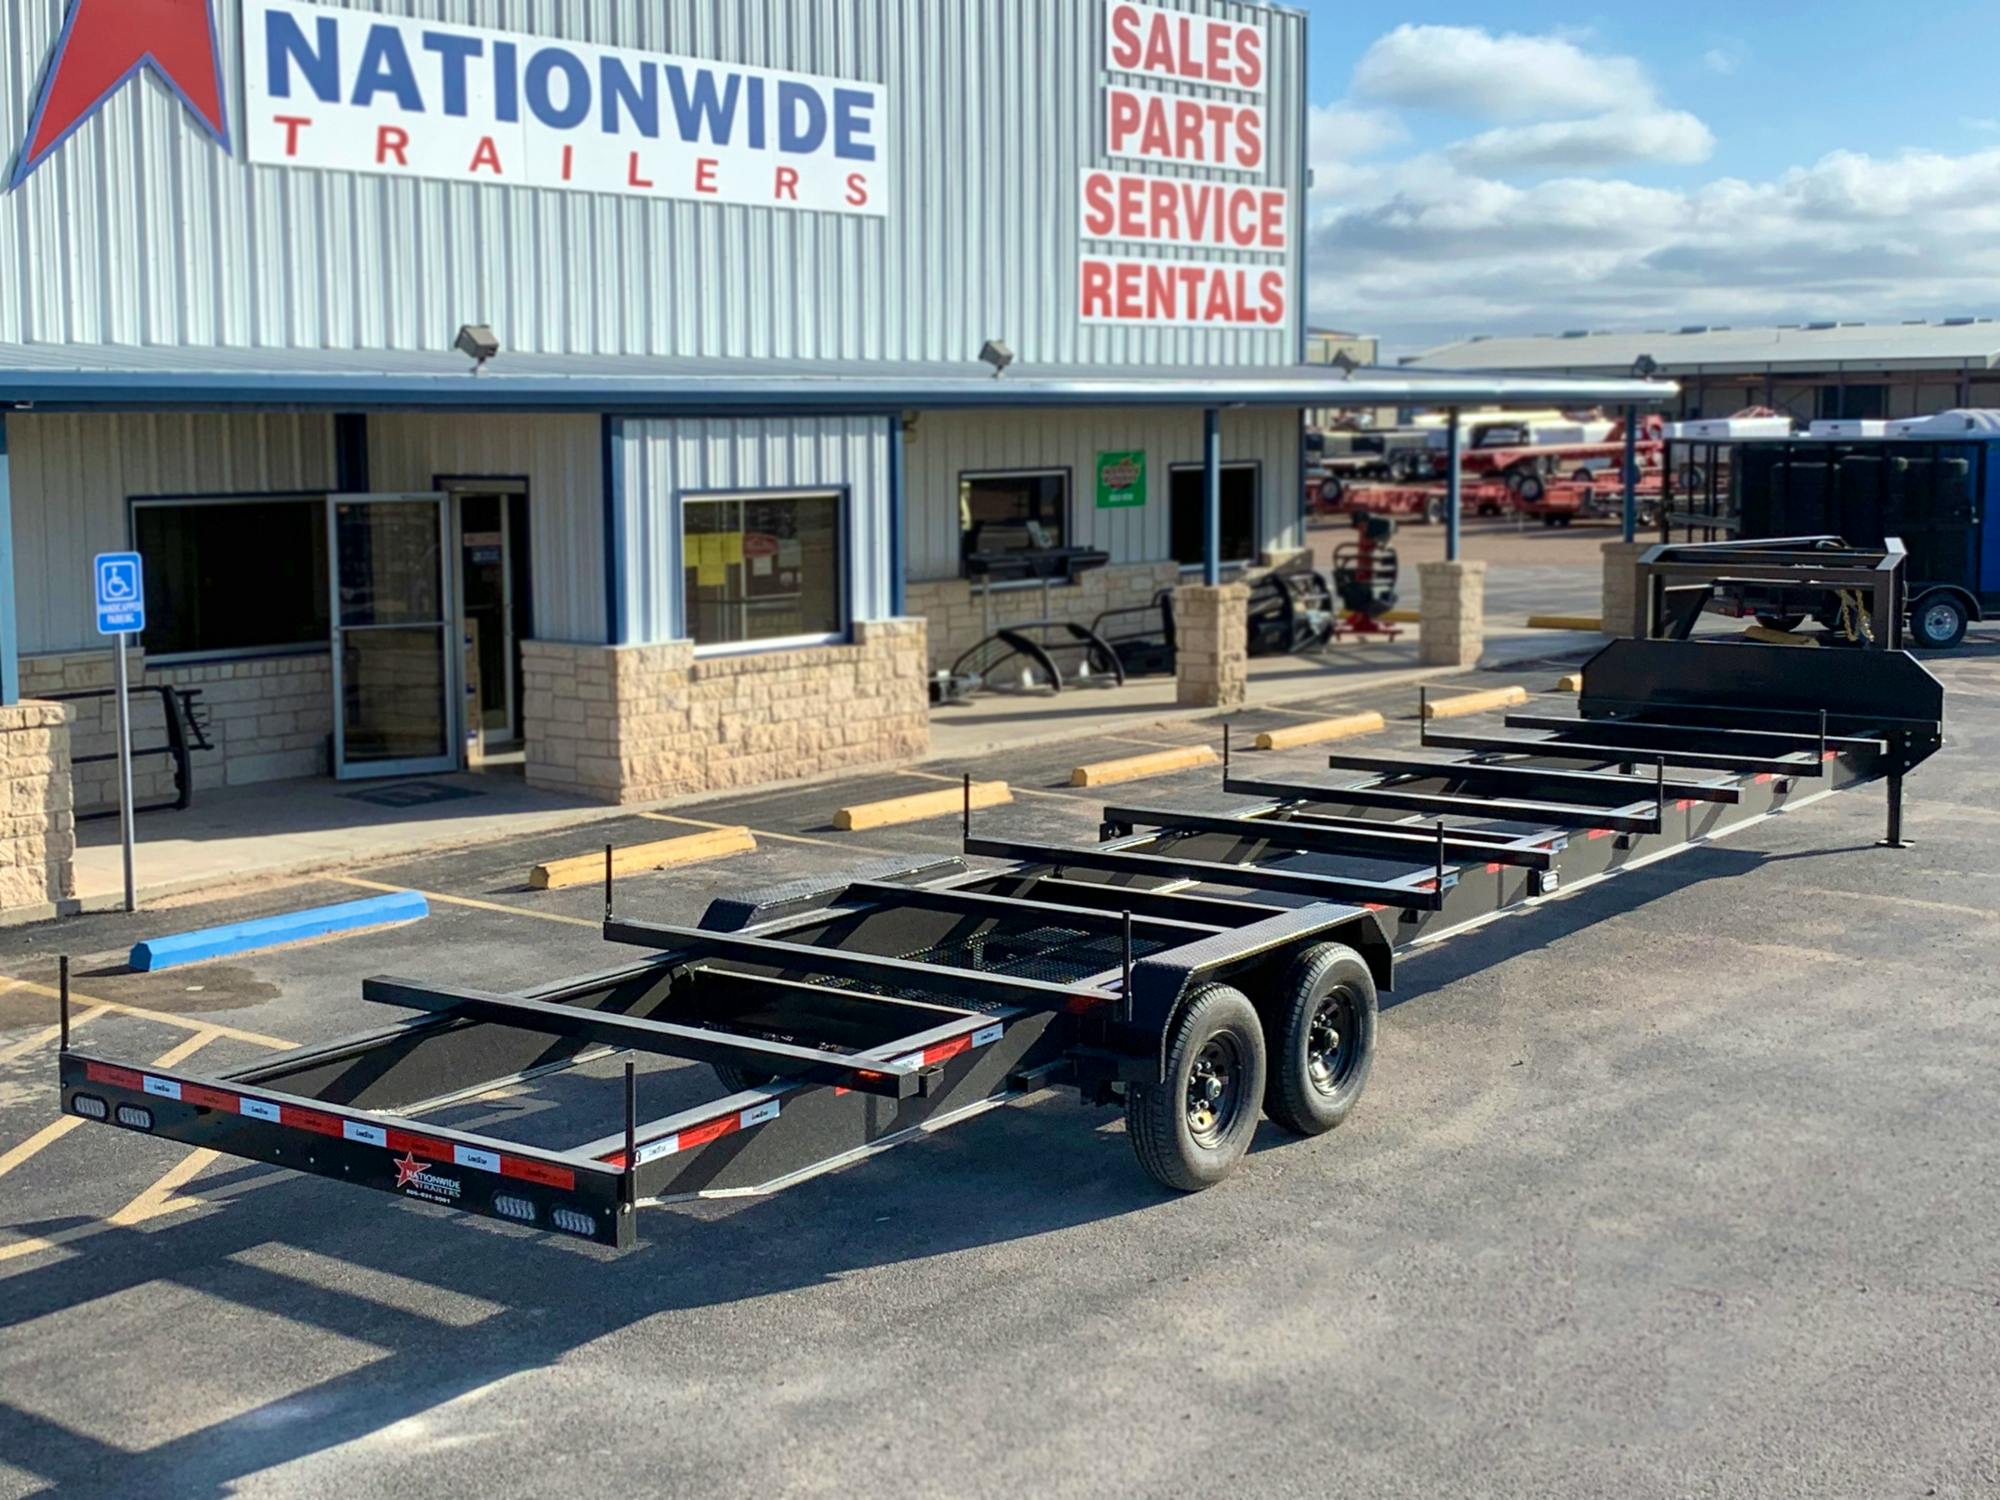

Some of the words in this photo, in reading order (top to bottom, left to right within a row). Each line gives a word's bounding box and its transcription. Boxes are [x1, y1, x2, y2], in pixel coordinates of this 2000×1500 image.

[1111, 4, 1261, 88] SALES
[264, 8, 877, 162] NATIONWIDE
[273, 115, 869, 207] TRAILERS
[1110, 90, 1261, 168] PARTS
[1085, 172, 1285, 247] SERVICE
[1082, 260, 1284, 325] RENTALS
[406, 1169, 461, 1190] NATIONWIDE
[419, 1183, 461, 1198] TRAILERS
